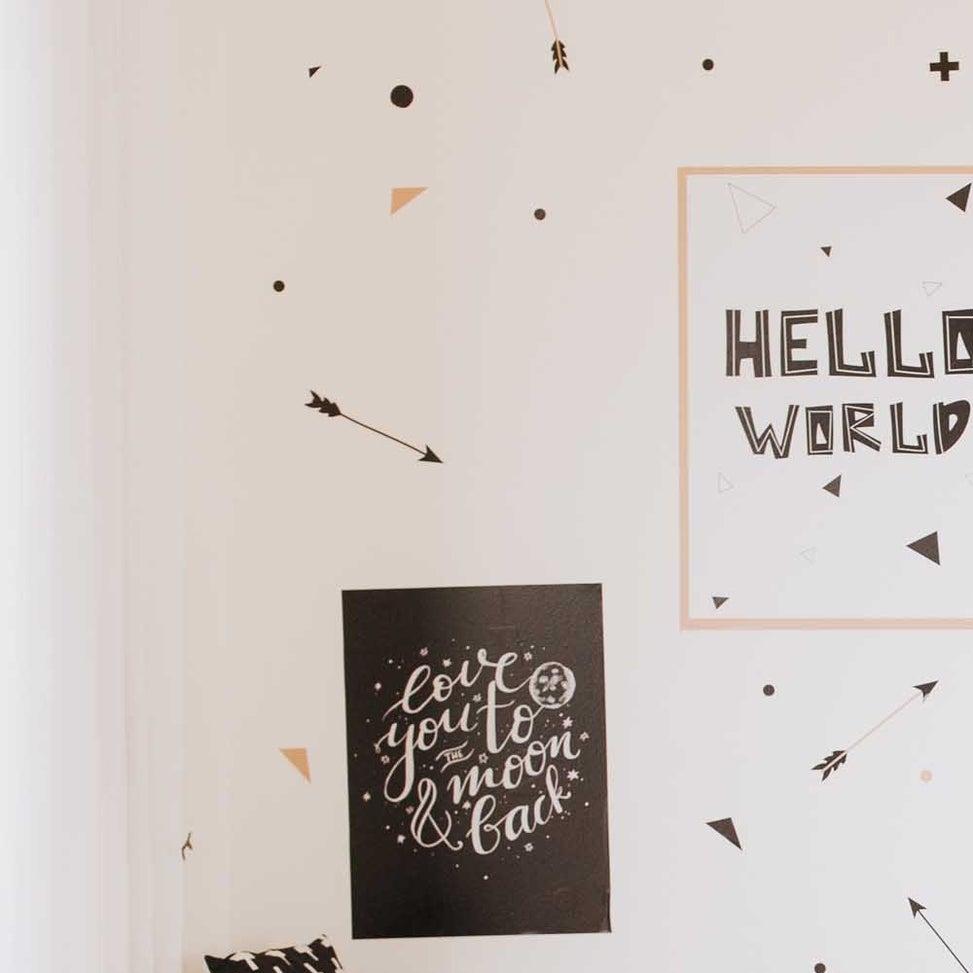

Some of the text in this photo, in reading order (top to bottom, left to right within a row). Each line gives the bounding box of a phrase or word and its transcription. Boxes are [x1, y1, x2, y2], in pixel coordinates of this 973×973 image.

[735, 399, 971, 459] WORLD
[382, 648, 533, 721] love
[375, 680, 546, 802] you to
[443, 748, 465, 761] THE
[446, 731, 581, 805] moon
[465, 764, 573, 855] back
